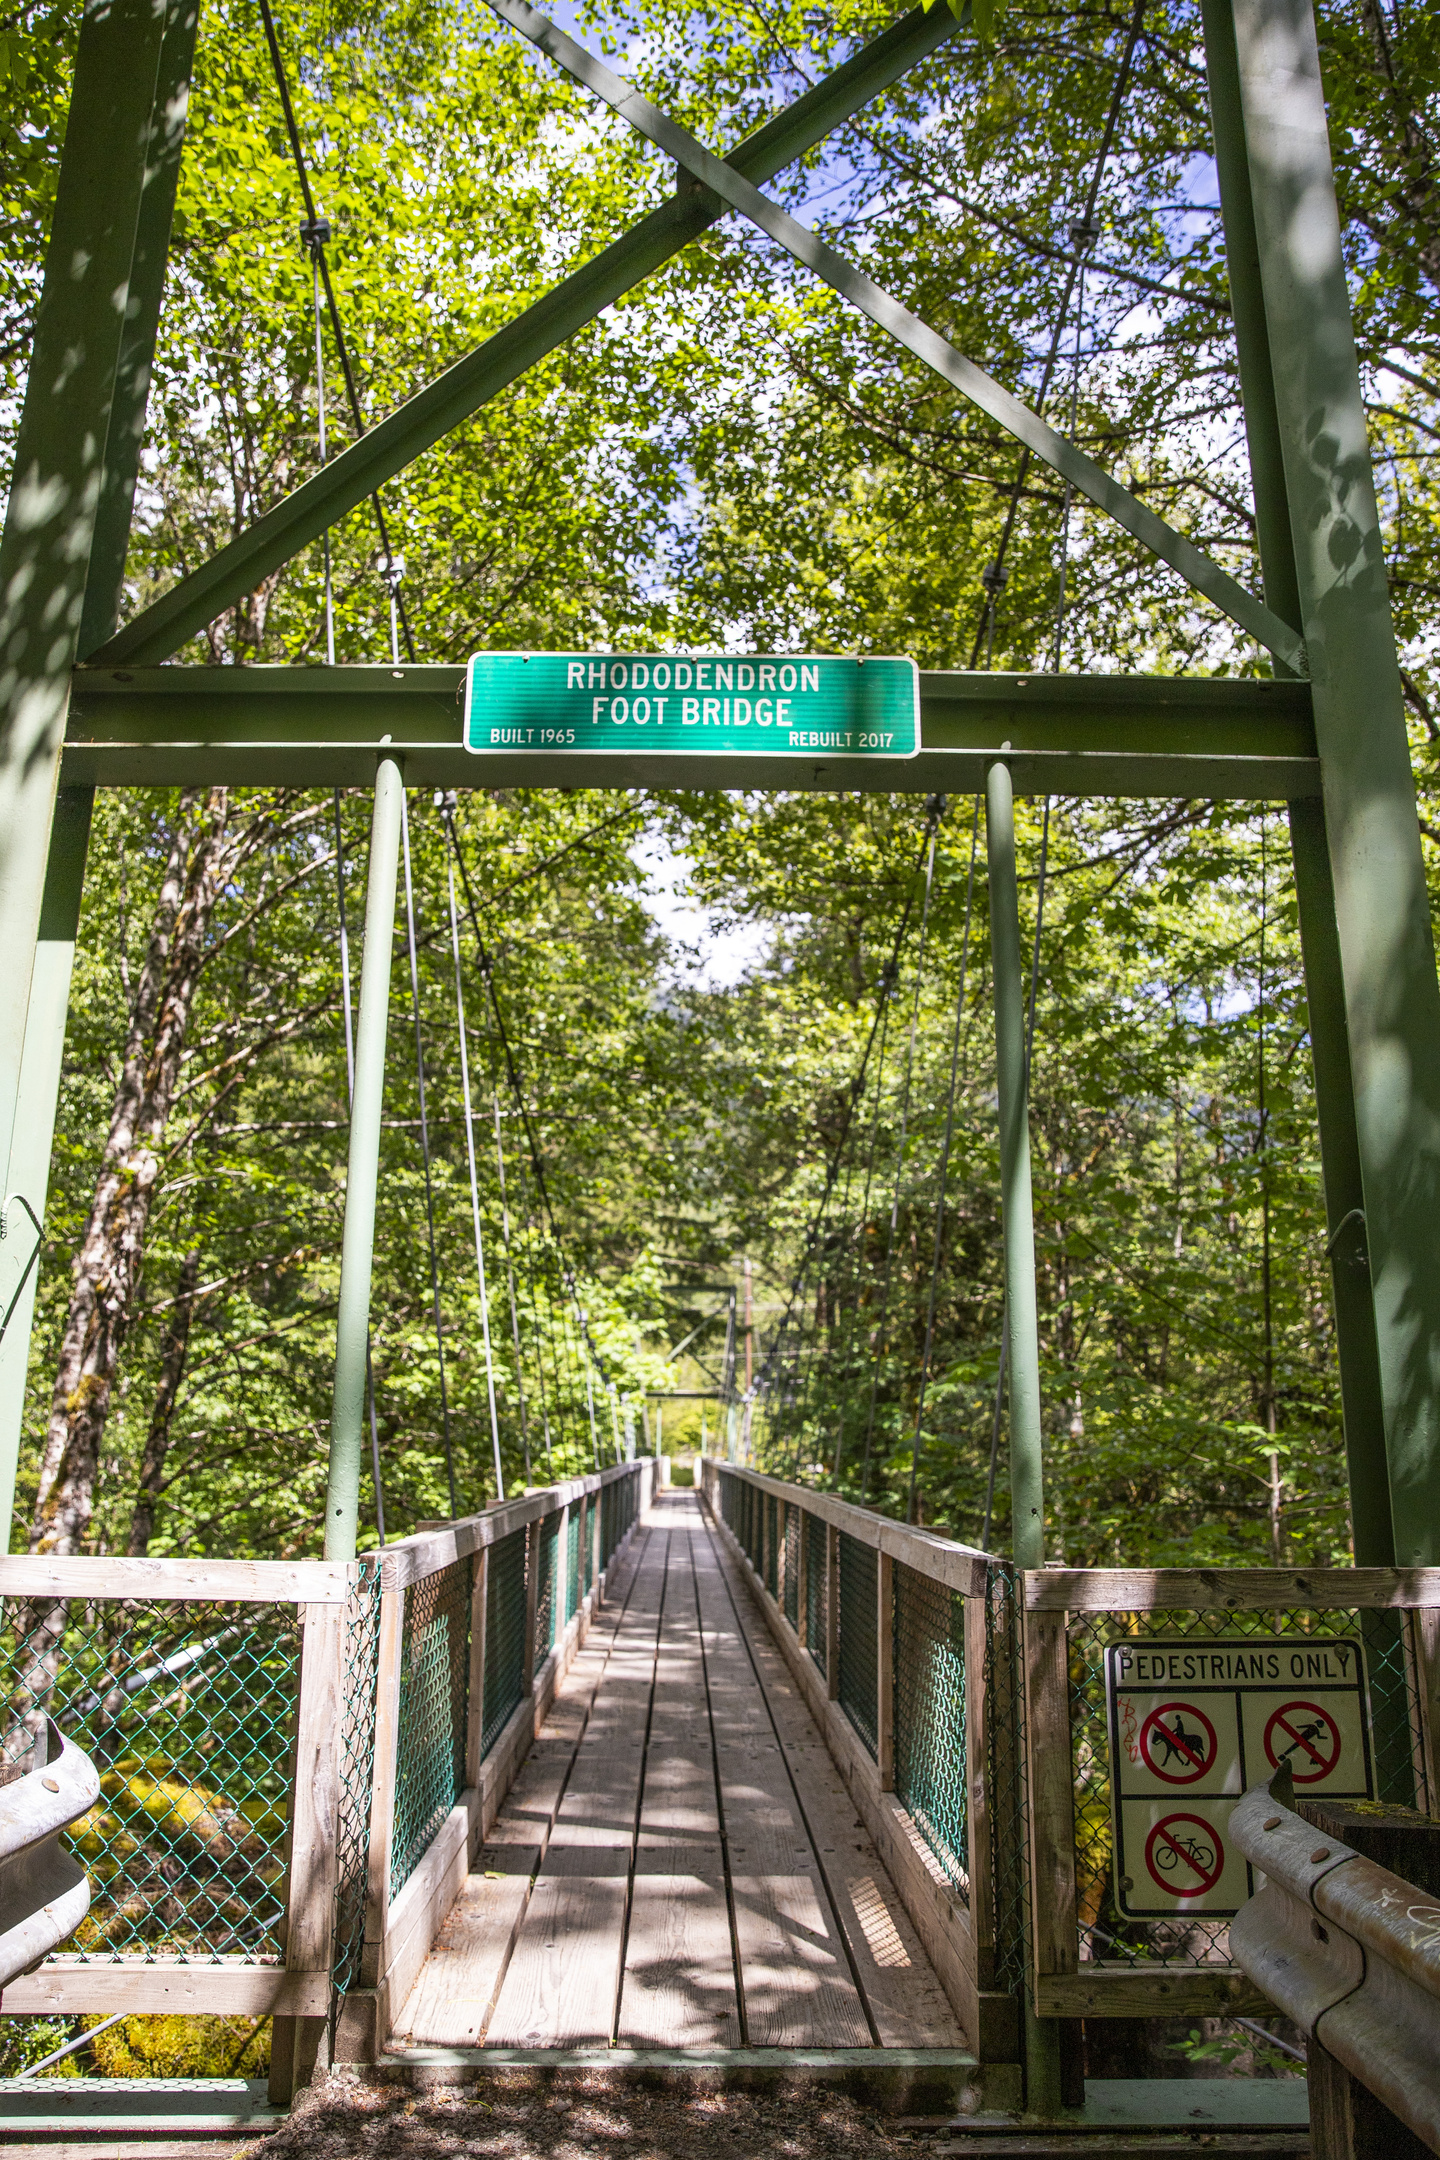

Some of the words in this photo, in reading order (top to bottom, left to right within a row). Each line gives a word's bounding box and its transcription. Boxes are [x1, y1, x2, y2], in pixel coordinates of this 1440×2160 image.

[567, 661, 820, 692] RHODODENDRON
[592, 696, 669, 725] FOOT
[682, 698, 793, 727] BRIDGE
[490, 729, 534, 744] BUILT
[540, 730, 576, 744] 1965
[789, 731, 853, 747] REBUILT
[858, 733, 894, 748] 2017
[1121, 1655, 1280, 1680] PEDESTRIANS
[1290, 1653, 1350, 1679] ONLY
